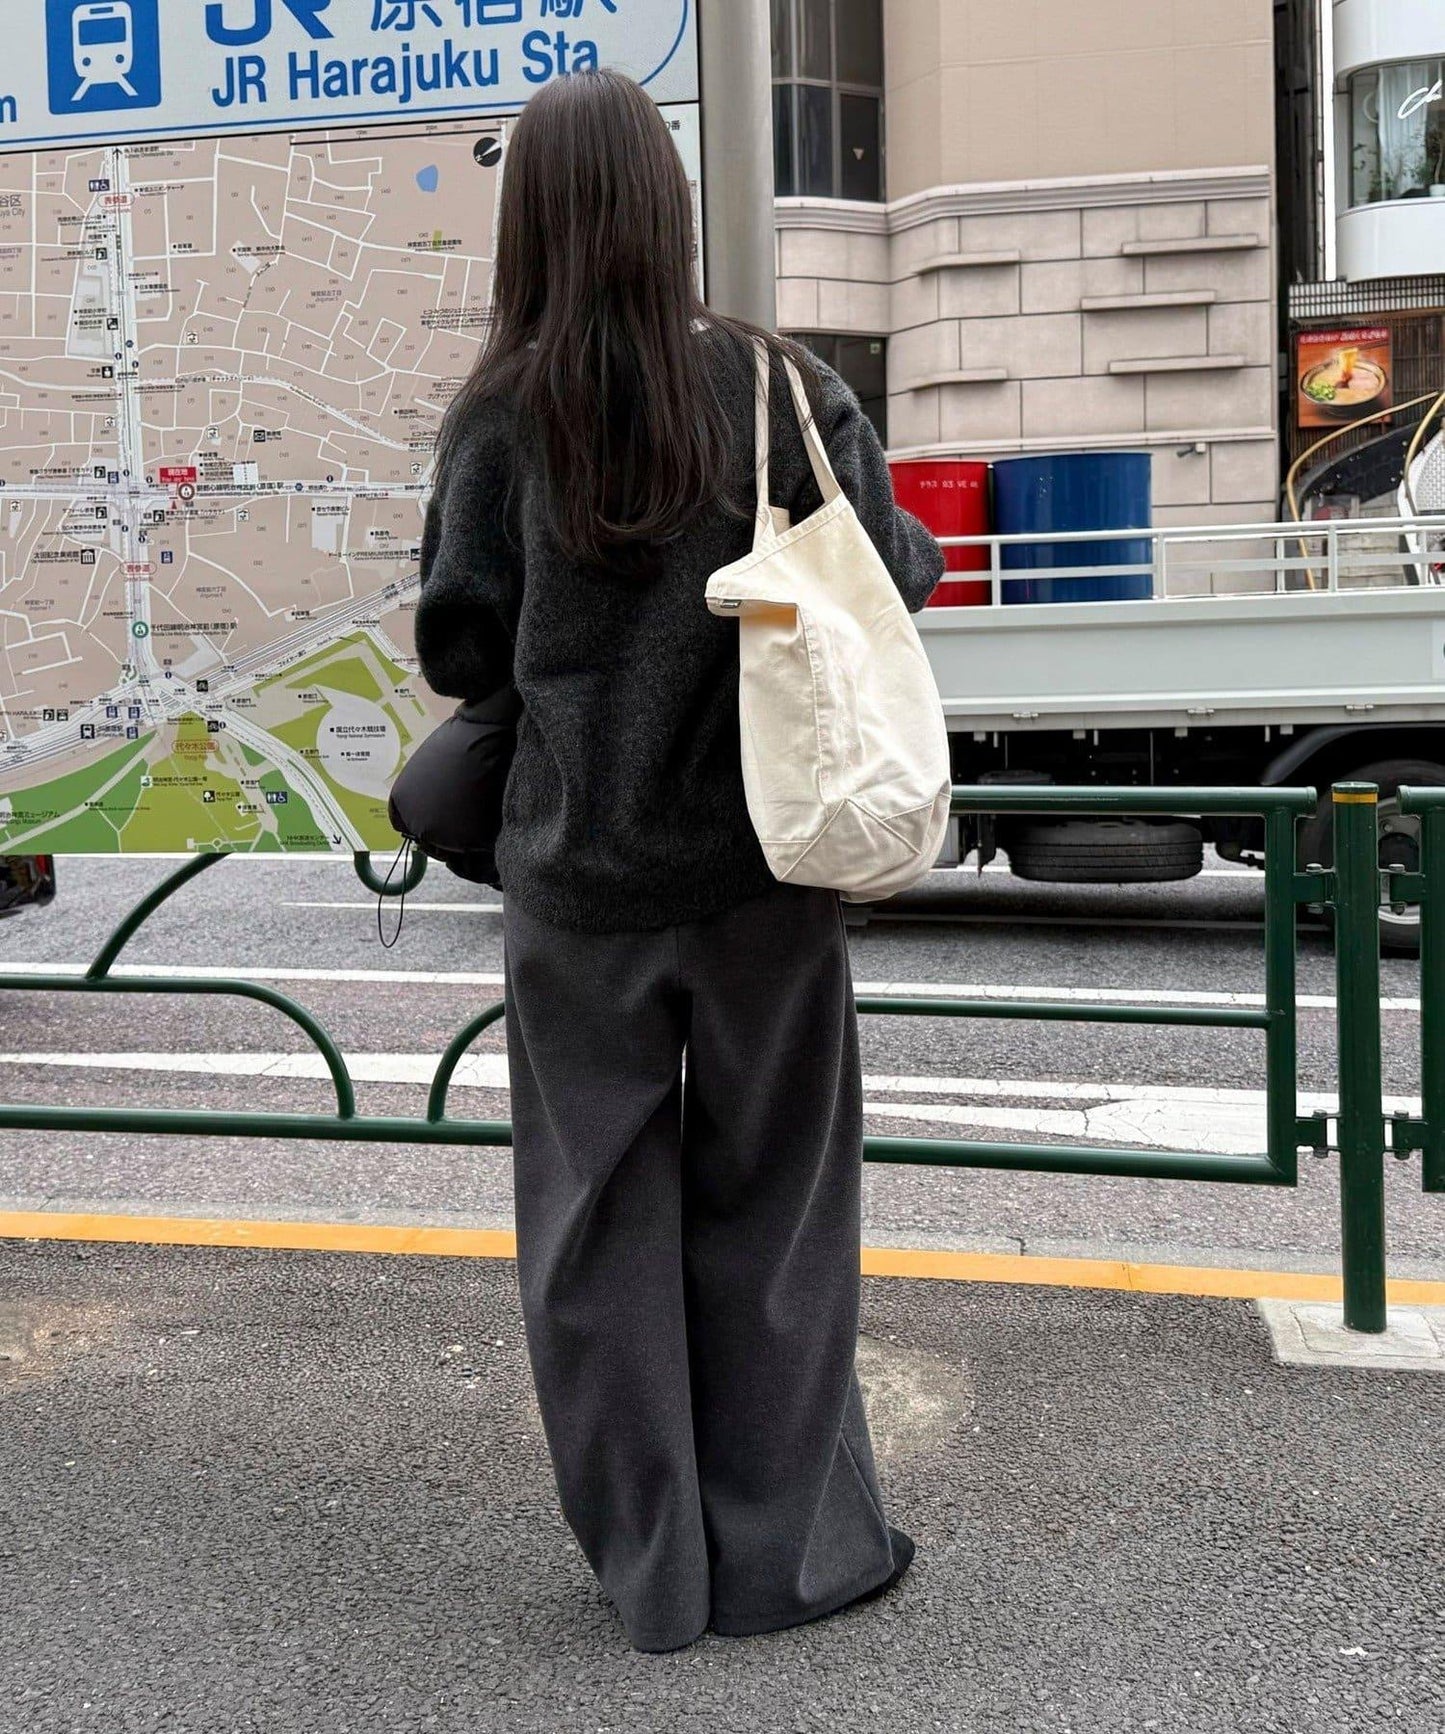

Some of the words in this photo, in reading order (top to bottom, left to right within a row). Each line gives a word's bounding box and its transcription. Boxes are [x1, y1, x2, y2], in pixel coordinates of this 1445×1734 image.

[211, 55, 267, 107] JR
[288, 39, 498, 104] Harajuku
[521, 30, 598, 84] Sta
